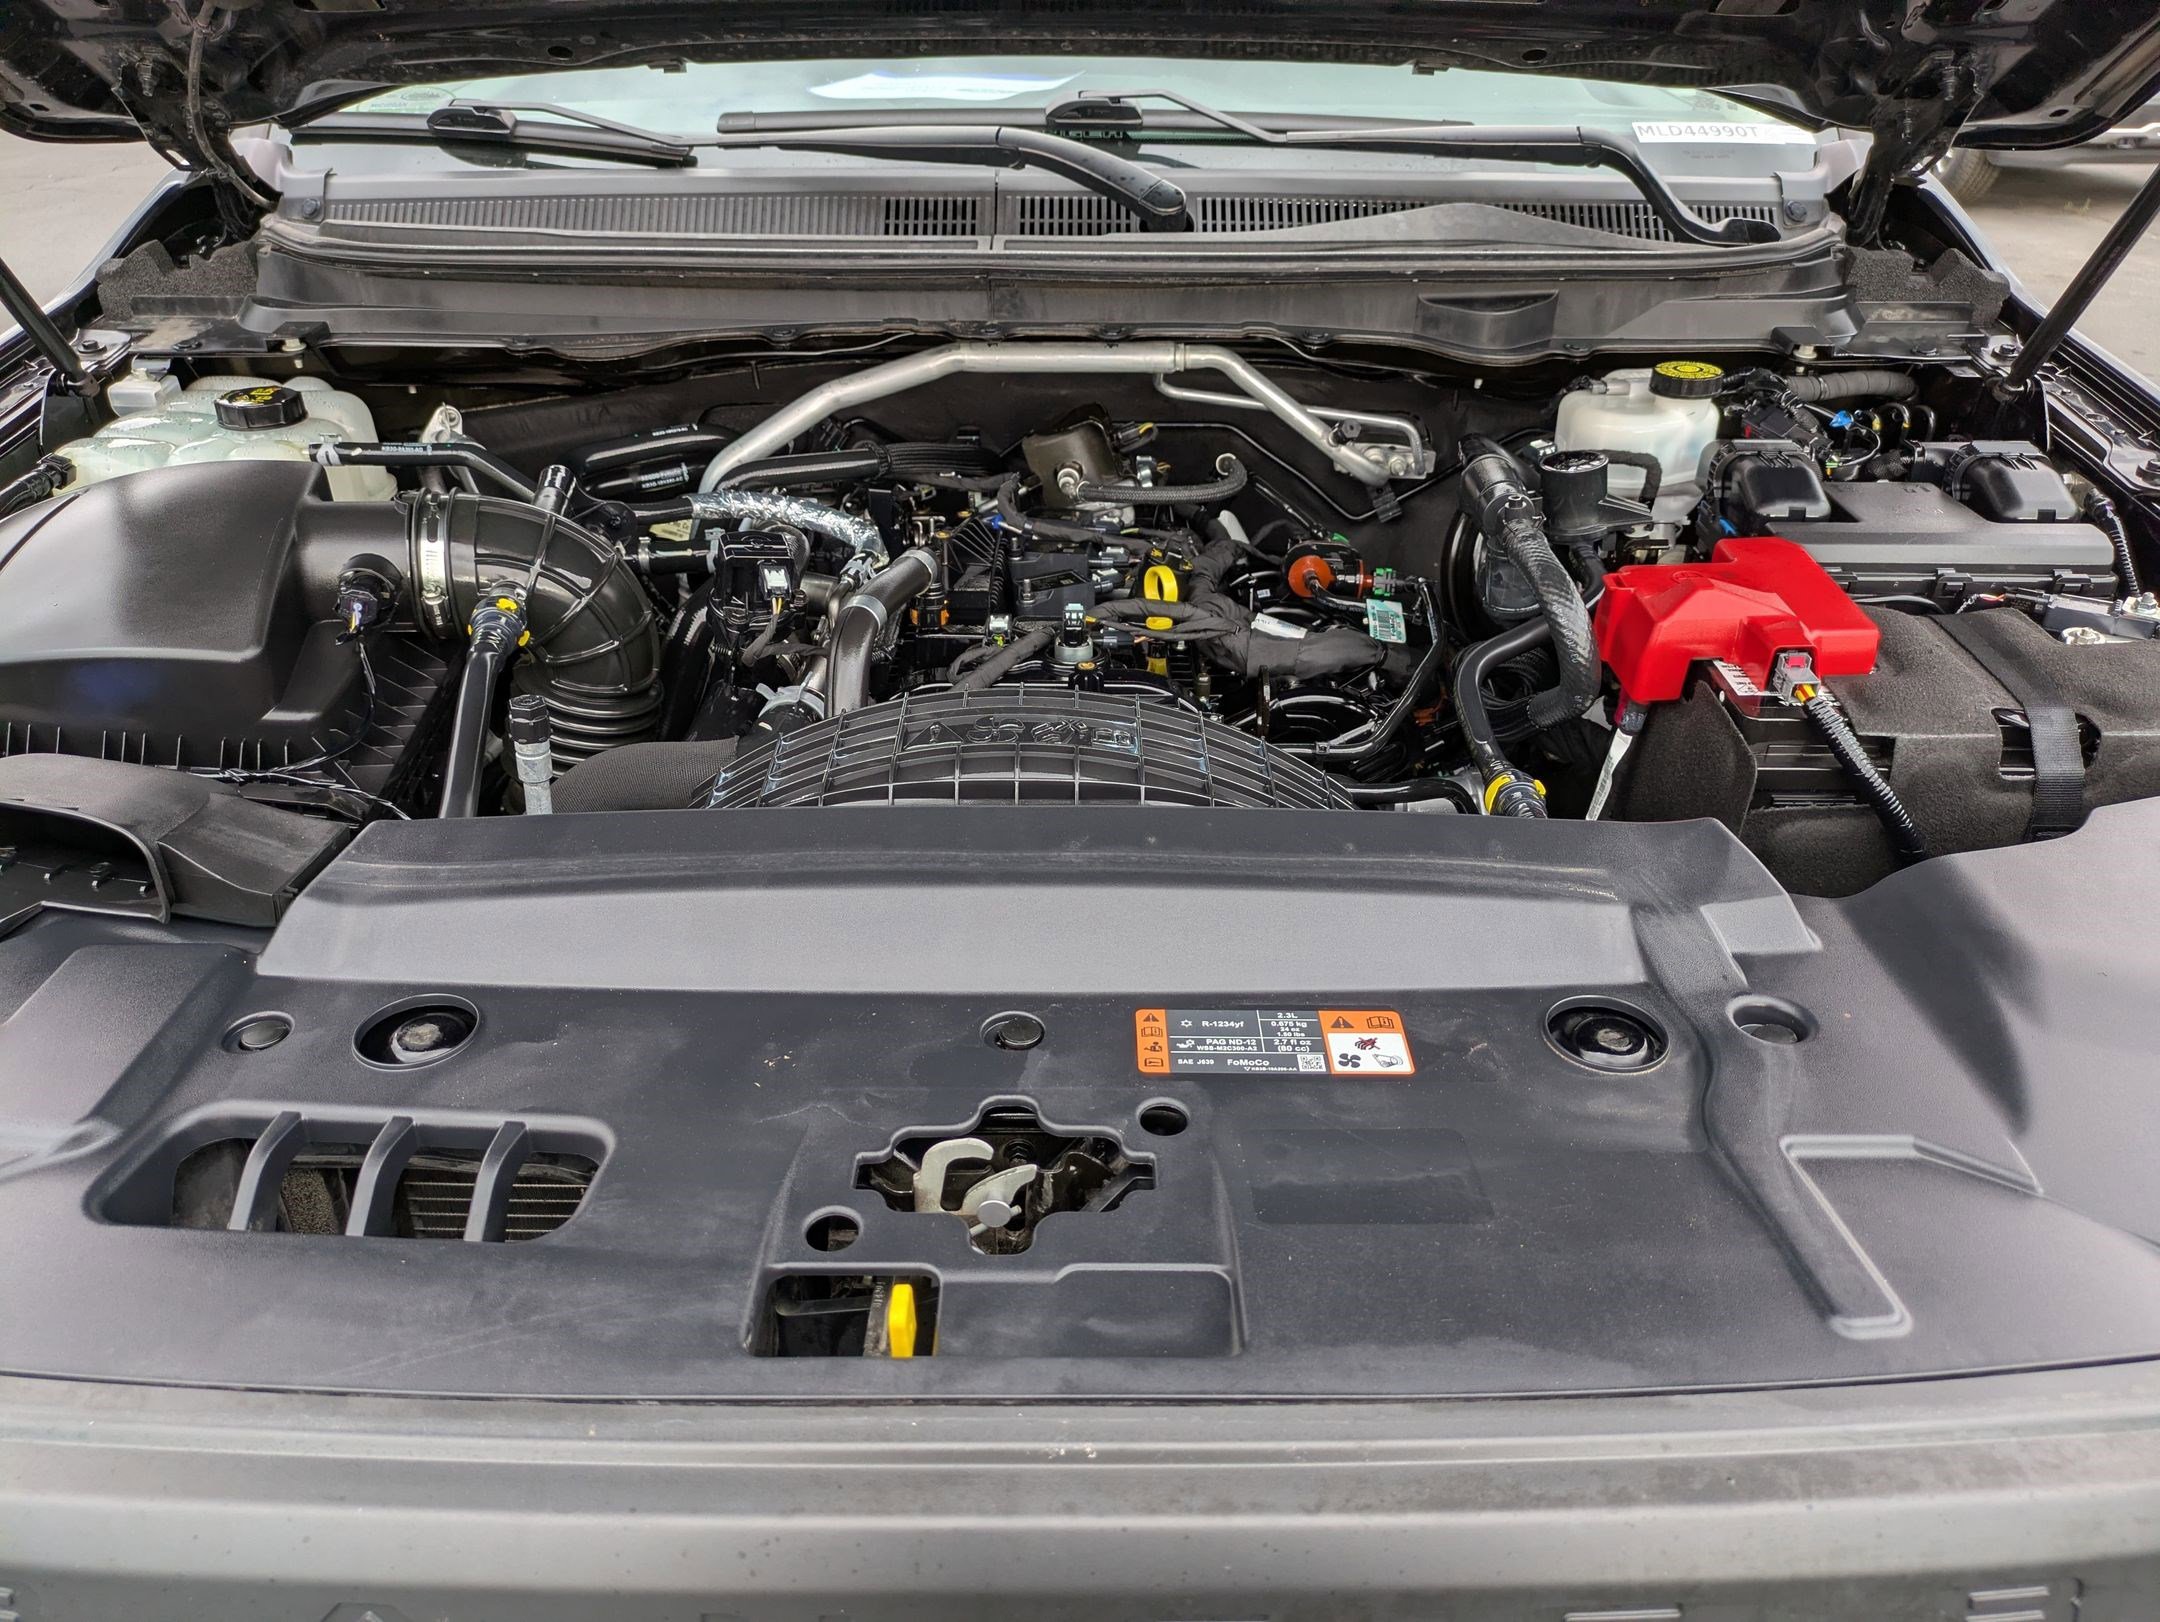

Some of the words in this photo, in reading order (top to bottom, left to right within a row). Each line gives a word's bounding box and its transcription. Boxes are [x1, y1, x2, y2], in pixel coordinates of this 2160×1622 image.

[1637, 125, 1758, 137] MLD44990T
[1201, 1020, 1244, 1029] R-1234yf
[1296, 1020, 1307, 1028] kg
[1294, 1045, 1310, 1053] cc)
[1227, 1058, 1270, 1066] FoMoCo
